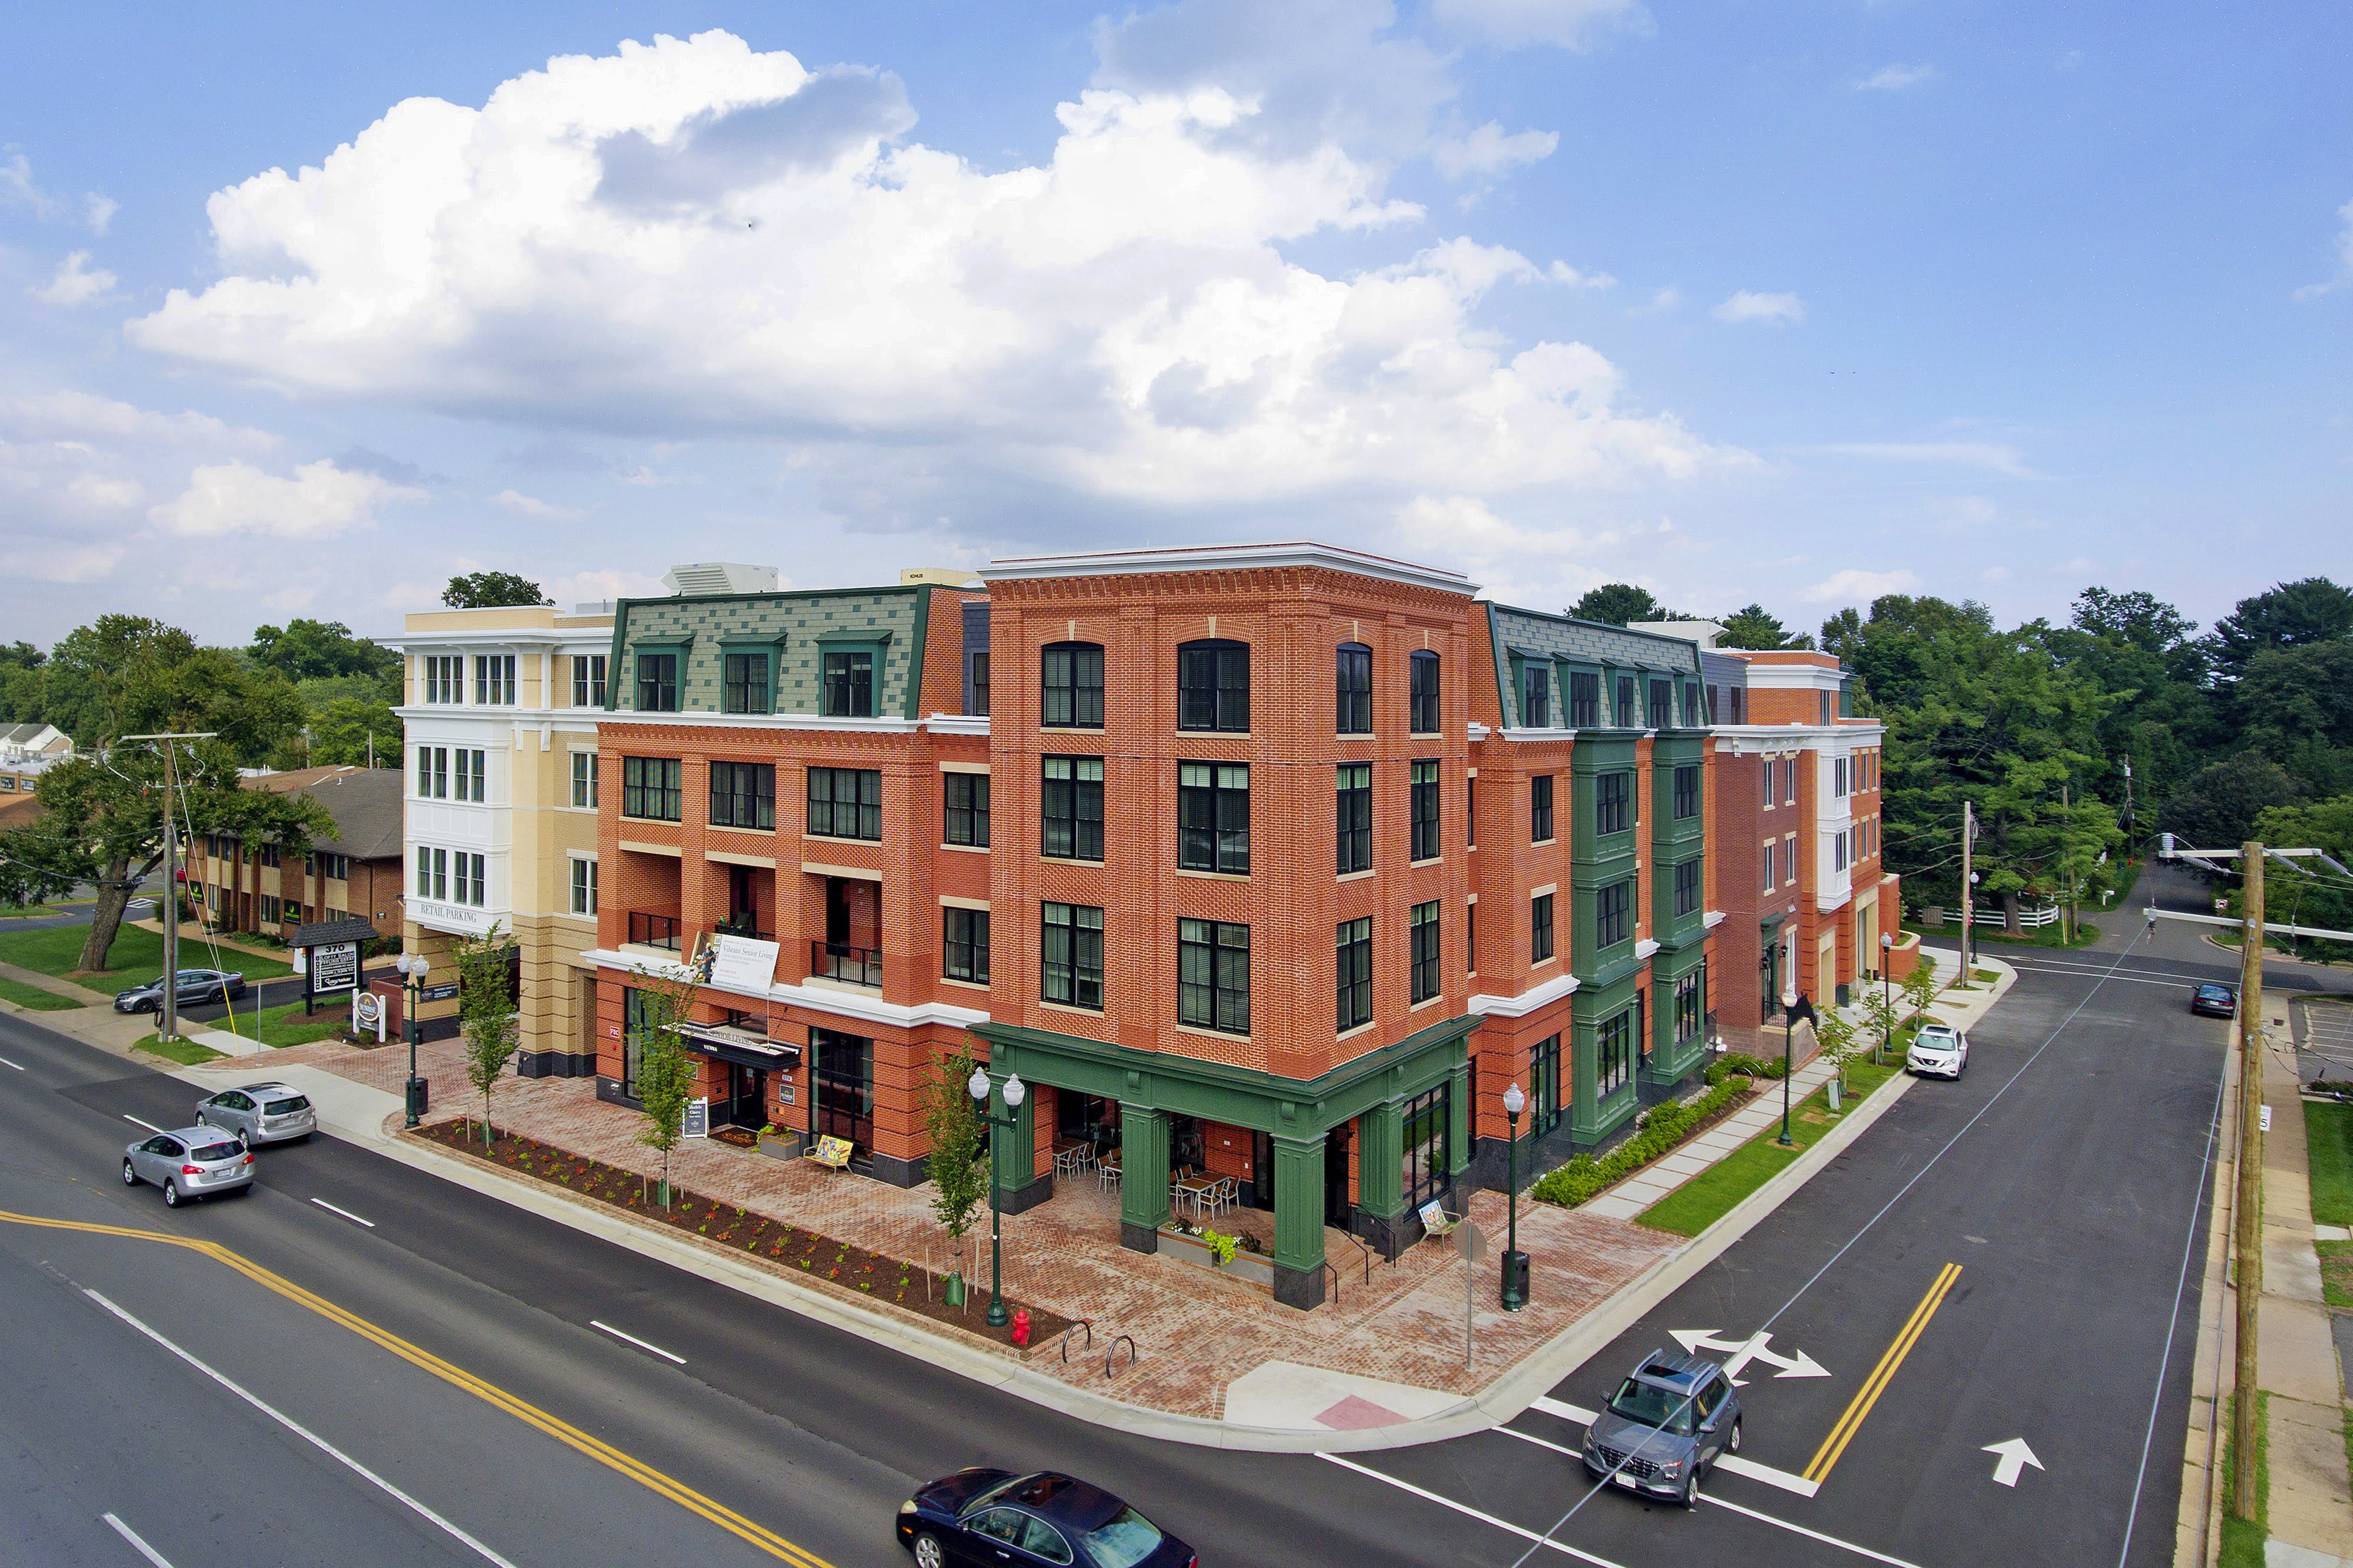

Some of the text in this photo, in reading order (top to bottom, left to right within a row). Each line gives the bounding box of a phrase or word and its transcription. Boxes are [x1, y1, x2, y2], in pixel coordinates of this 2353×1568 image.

[421, 904, 476, 923] RETAIL PARKING
[325, 944, 345, 953] 370
[723, 945, 741, 954] Vibrant
[742, 948, 757, 956] Senior
[758, 950, 774, 961] Living
[2260, 1118, 2268, 1127] 5
